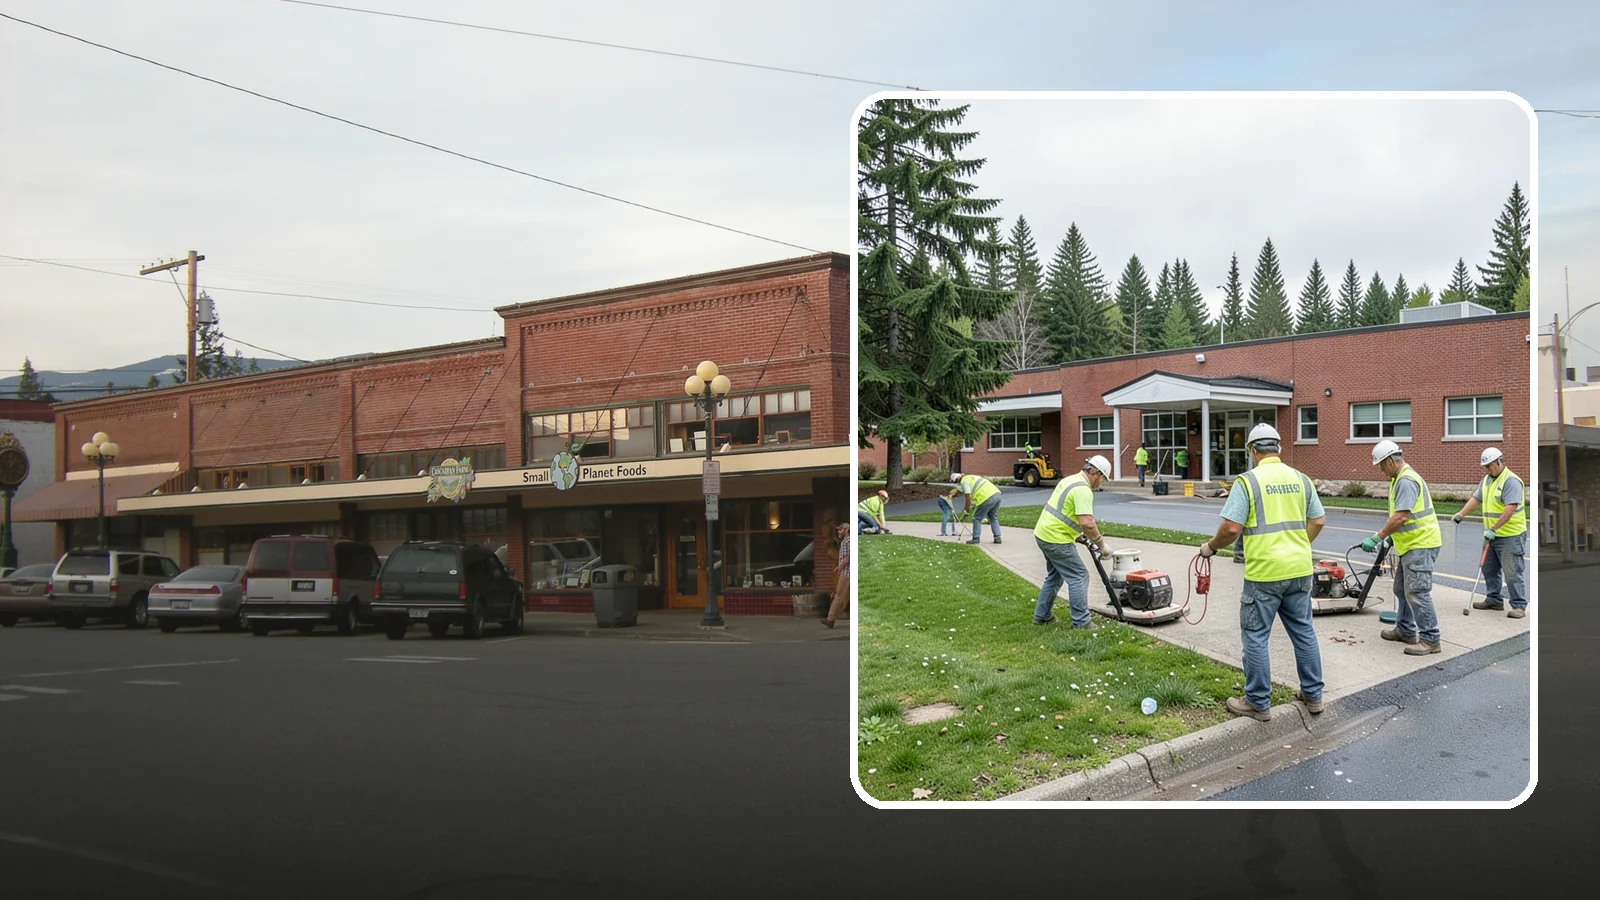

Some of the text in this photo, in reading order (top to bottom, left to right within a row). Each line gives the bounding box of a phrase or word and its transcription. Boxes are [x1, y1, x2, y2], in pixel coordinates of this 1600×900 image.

[523, 464, 647, 483] Small Planet Foods
